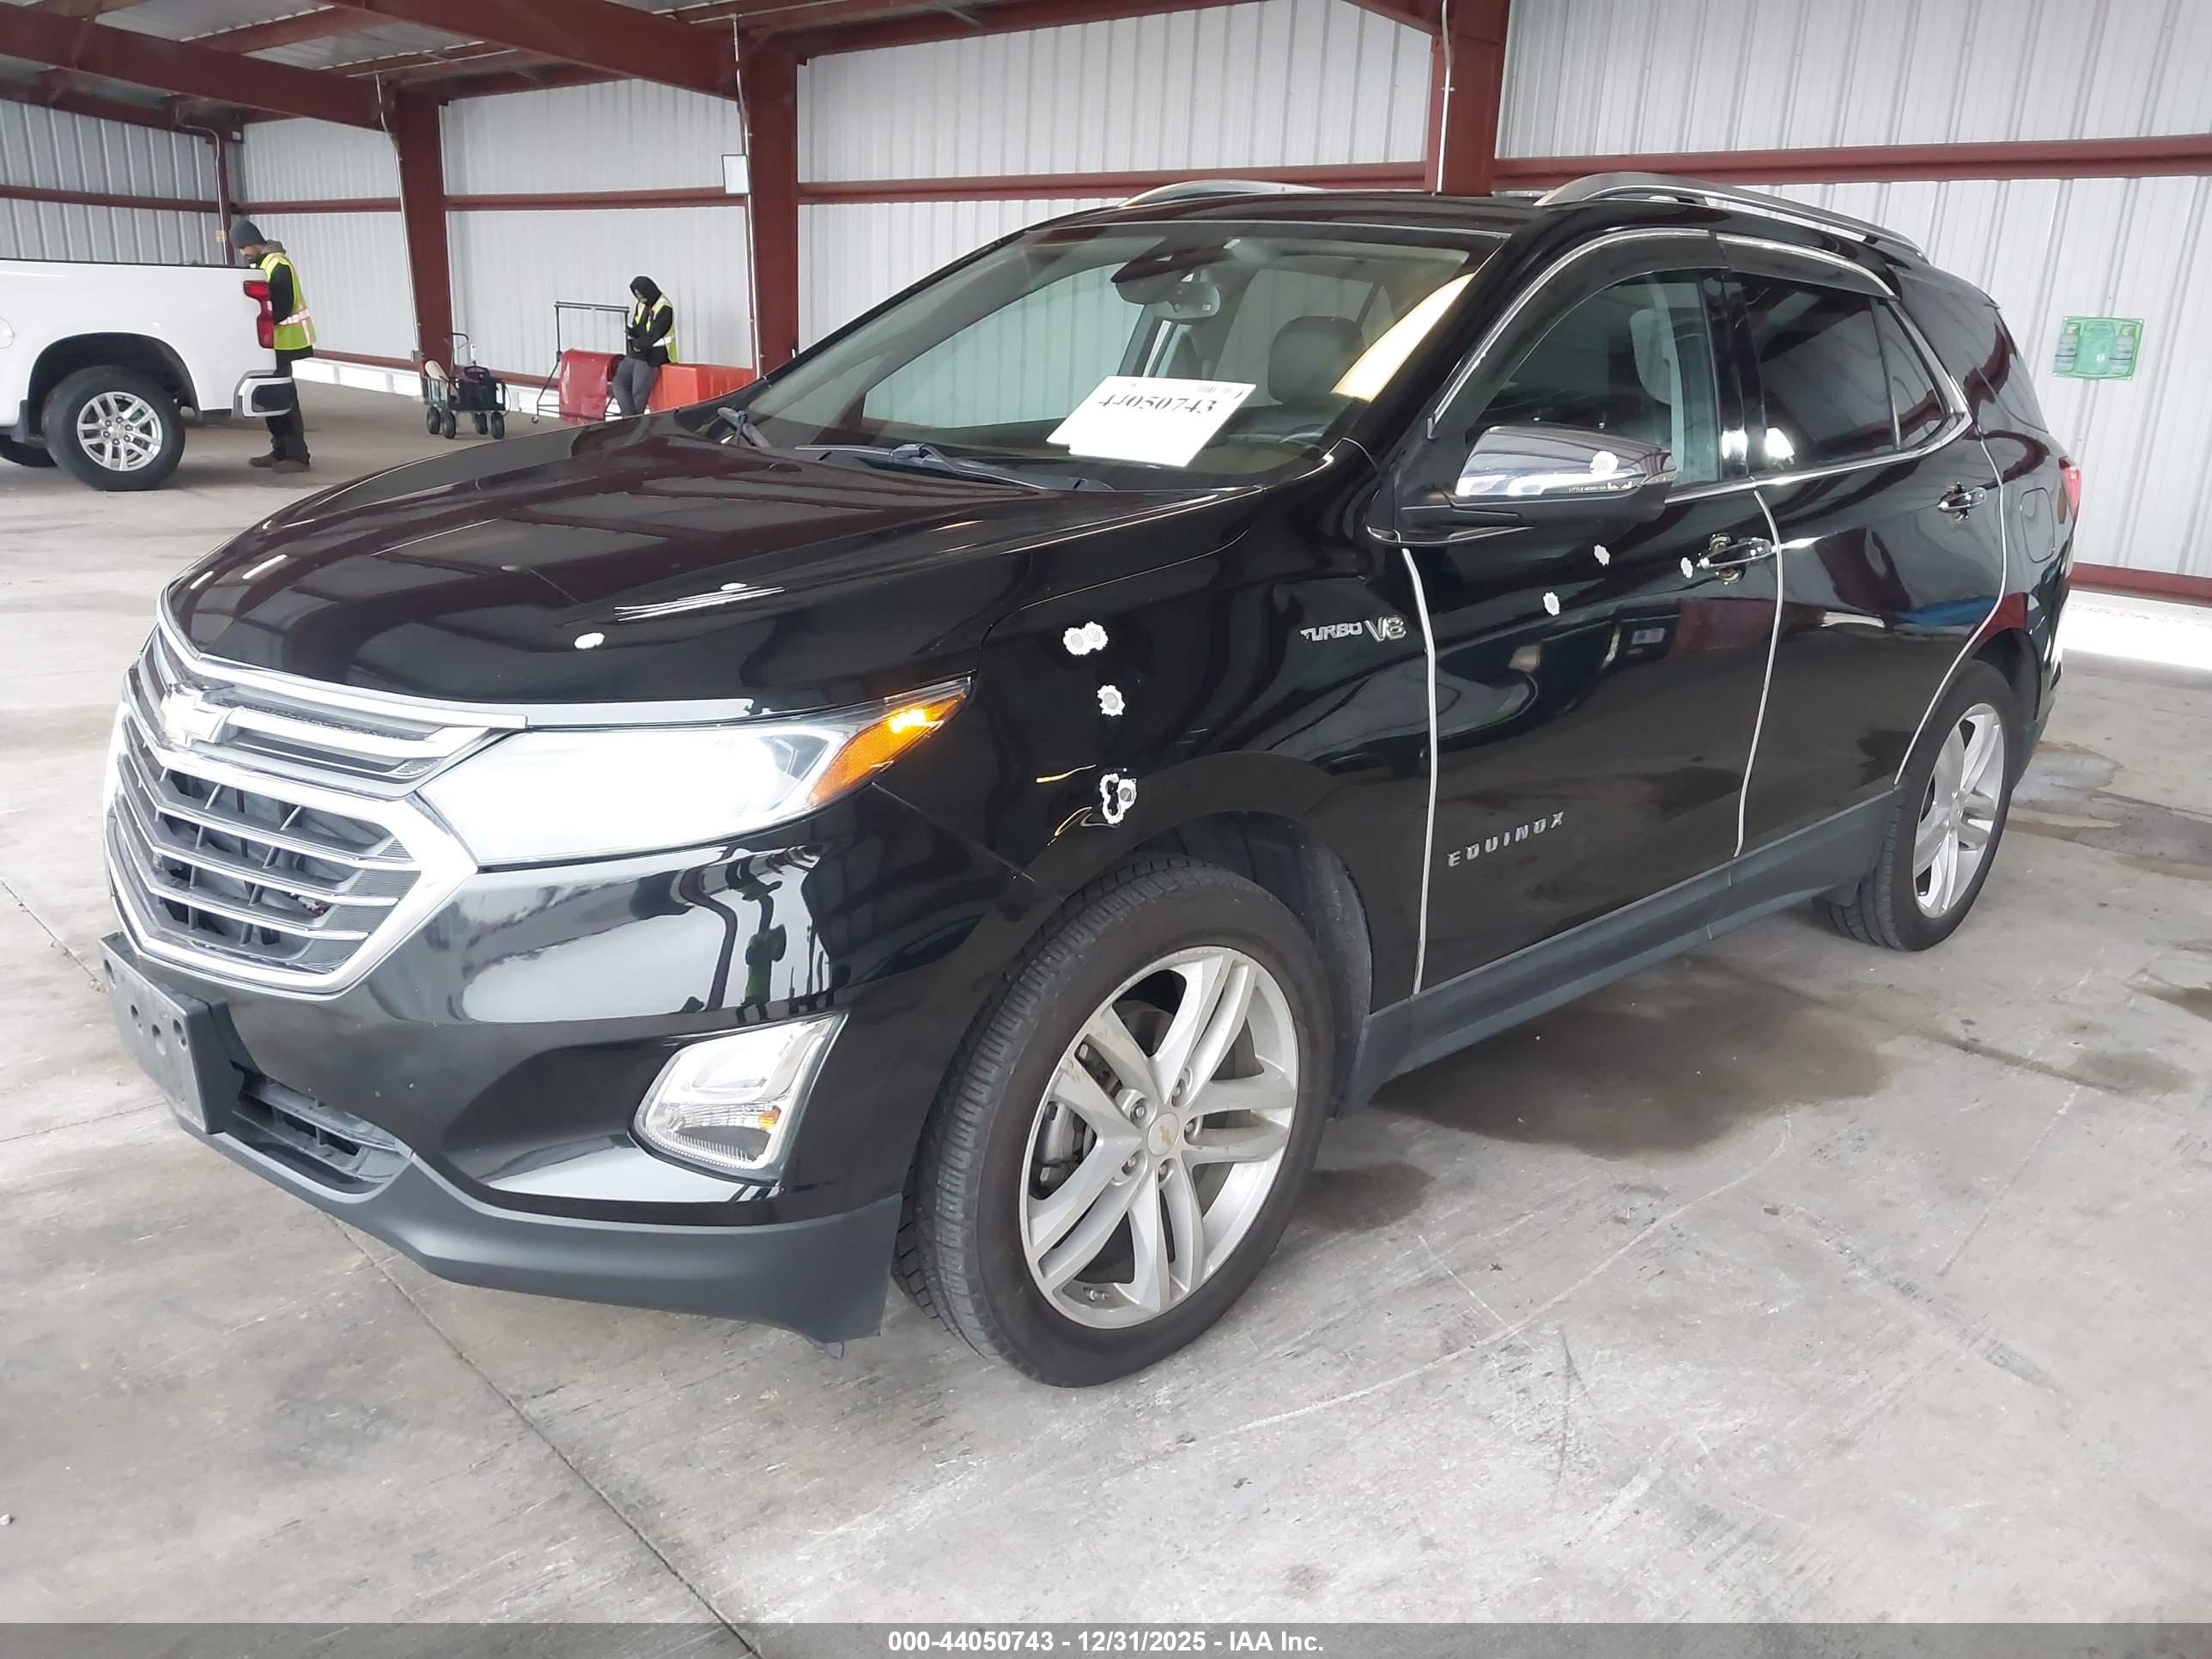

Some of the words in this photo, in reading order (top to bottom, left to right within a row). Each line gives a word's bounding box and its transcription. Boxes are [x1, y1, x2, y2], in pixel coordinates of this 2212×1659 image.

[1097, 393, 1218, 414] 44050743
[1299, 622, 1363, 641] TURBO
[1364, 617, 1407, 642] V8
[1446, 811, 1565, 867] EQUINOX
